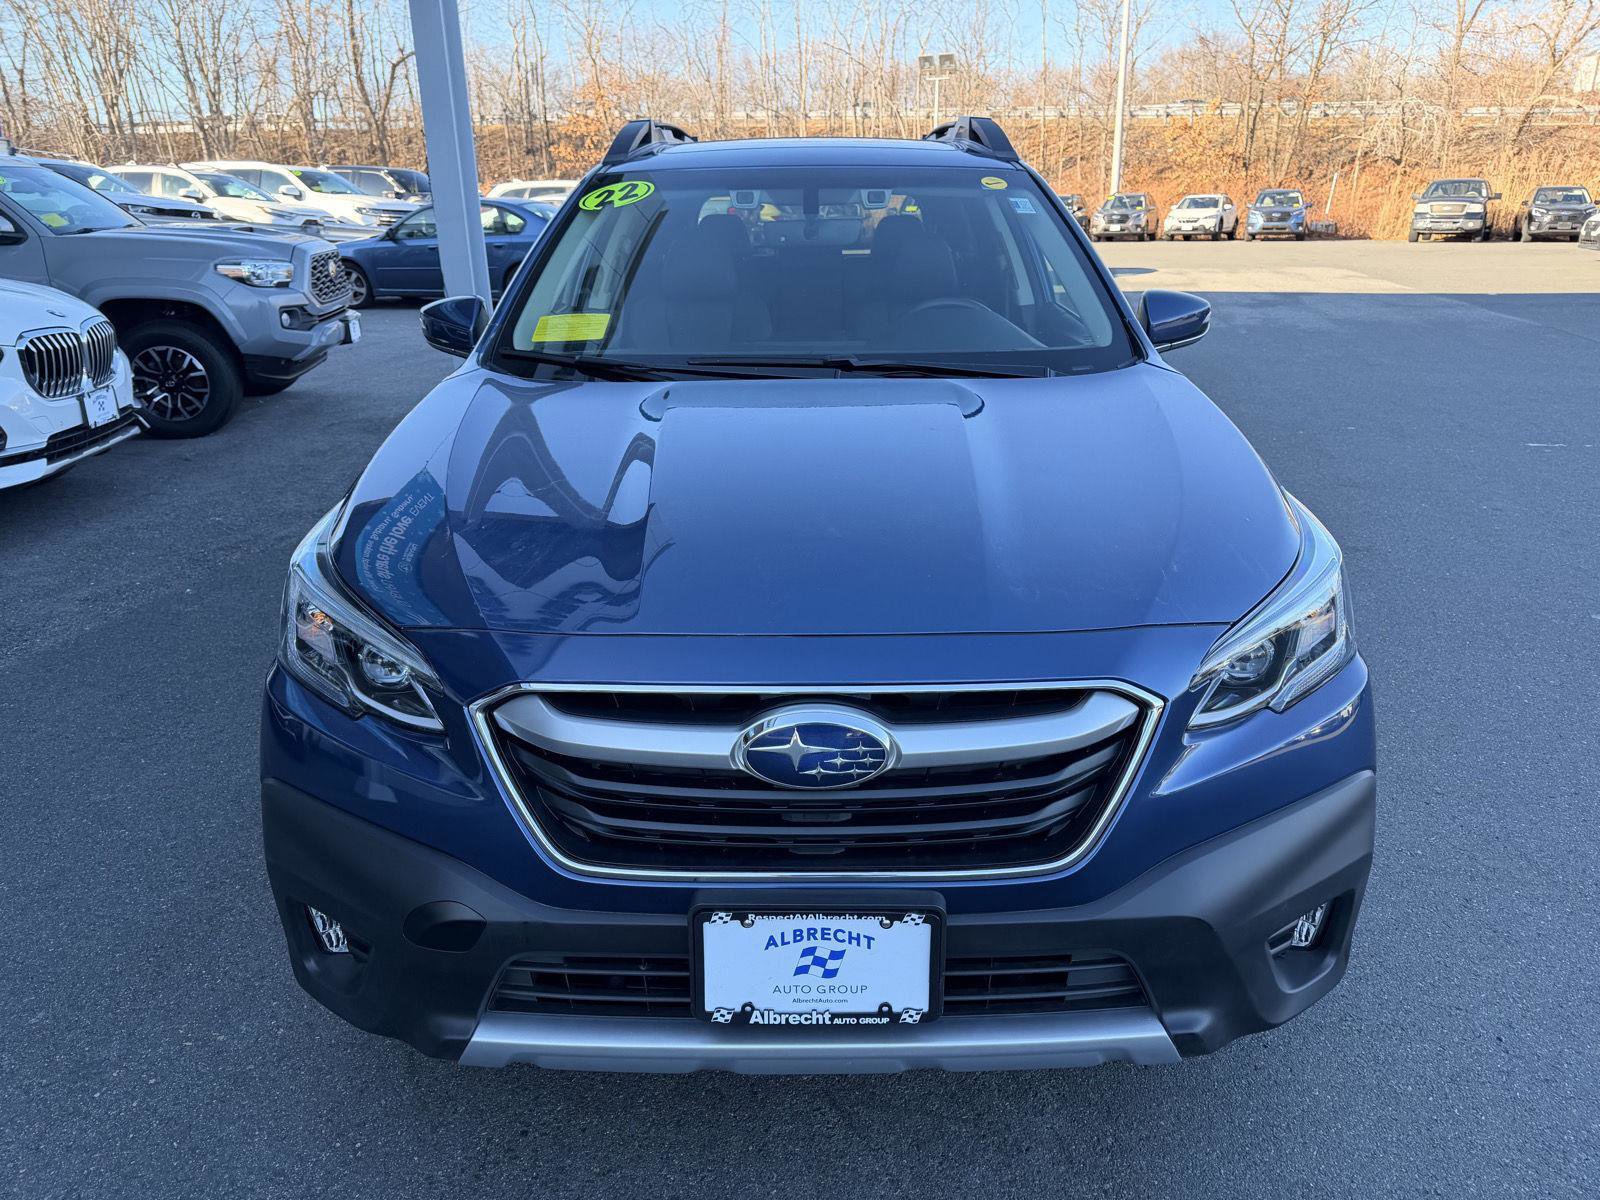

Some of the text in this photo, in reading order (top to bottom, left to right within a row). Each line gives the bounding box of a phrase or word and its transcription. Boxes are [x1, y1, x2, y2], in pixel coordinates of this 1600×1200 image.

[764, 927, 875, 950] ALBRECHT
[772, 985, 868, 994] AUTO GROUP
[750, 1009, 831, 1025] Albrecht
